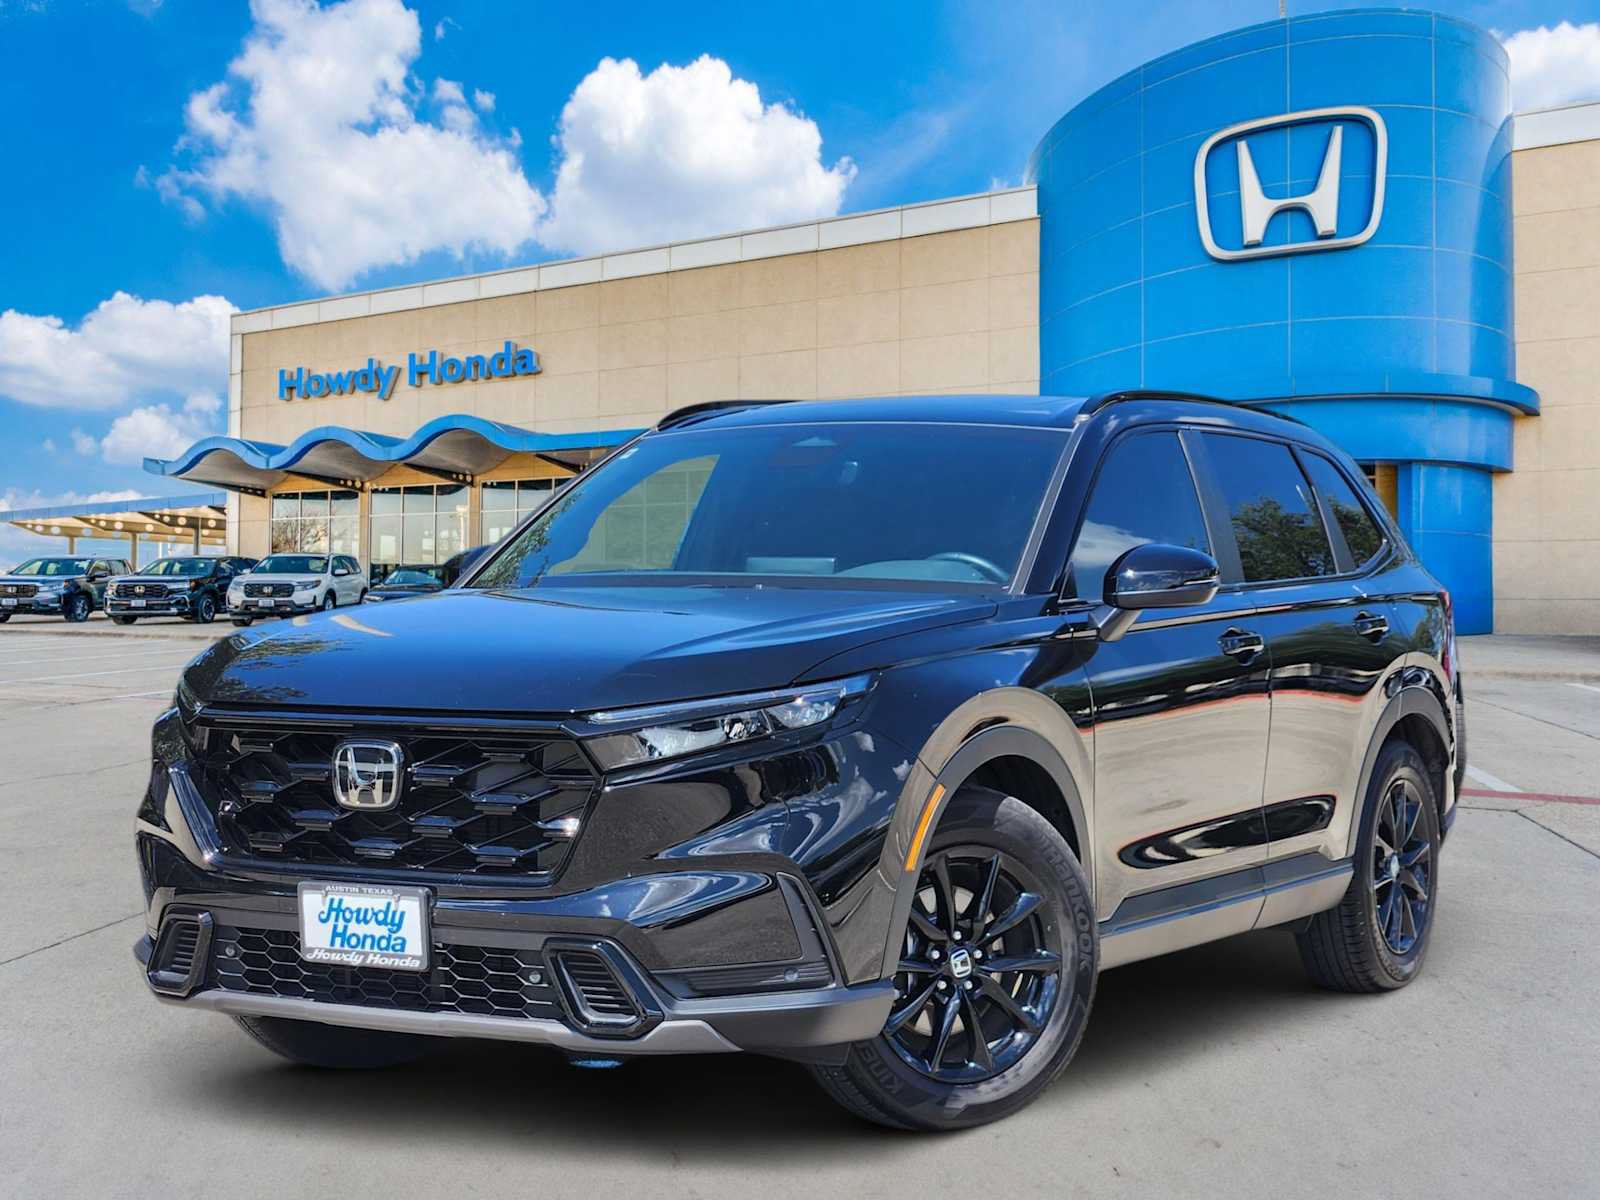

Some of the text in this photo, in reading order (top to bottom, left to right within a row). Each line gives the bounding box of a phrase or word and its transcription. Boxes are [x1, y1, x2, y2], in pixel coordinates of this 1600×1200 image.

[278, 340, 542, 401] Howdy Honda
[325, 884, 393, 896] AUSTIN TEXAS
[318, 897, 406, 934] Howdy
[329, 923, 407, 953] Honda
[306, 948, 421, 968] Howdy Honda
